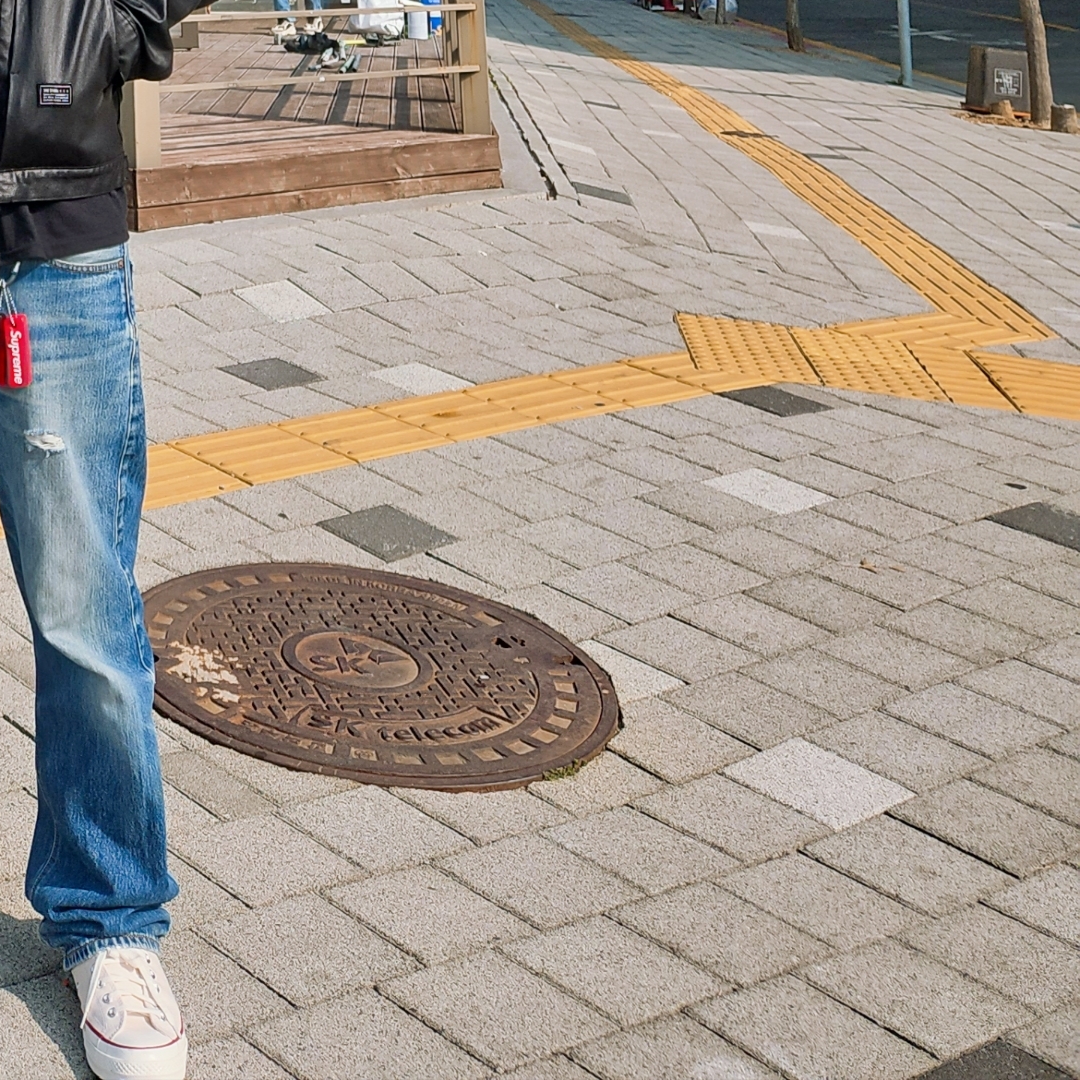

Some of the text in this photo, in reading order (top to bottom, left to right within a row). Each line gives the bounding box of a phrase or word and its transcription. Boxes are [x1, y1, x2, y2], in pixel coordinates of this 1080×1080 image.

[8, 330, 23, 385] Supreme
[309, 655, 371, 674] SK
[307, 715, 503, 742] SK telecom
